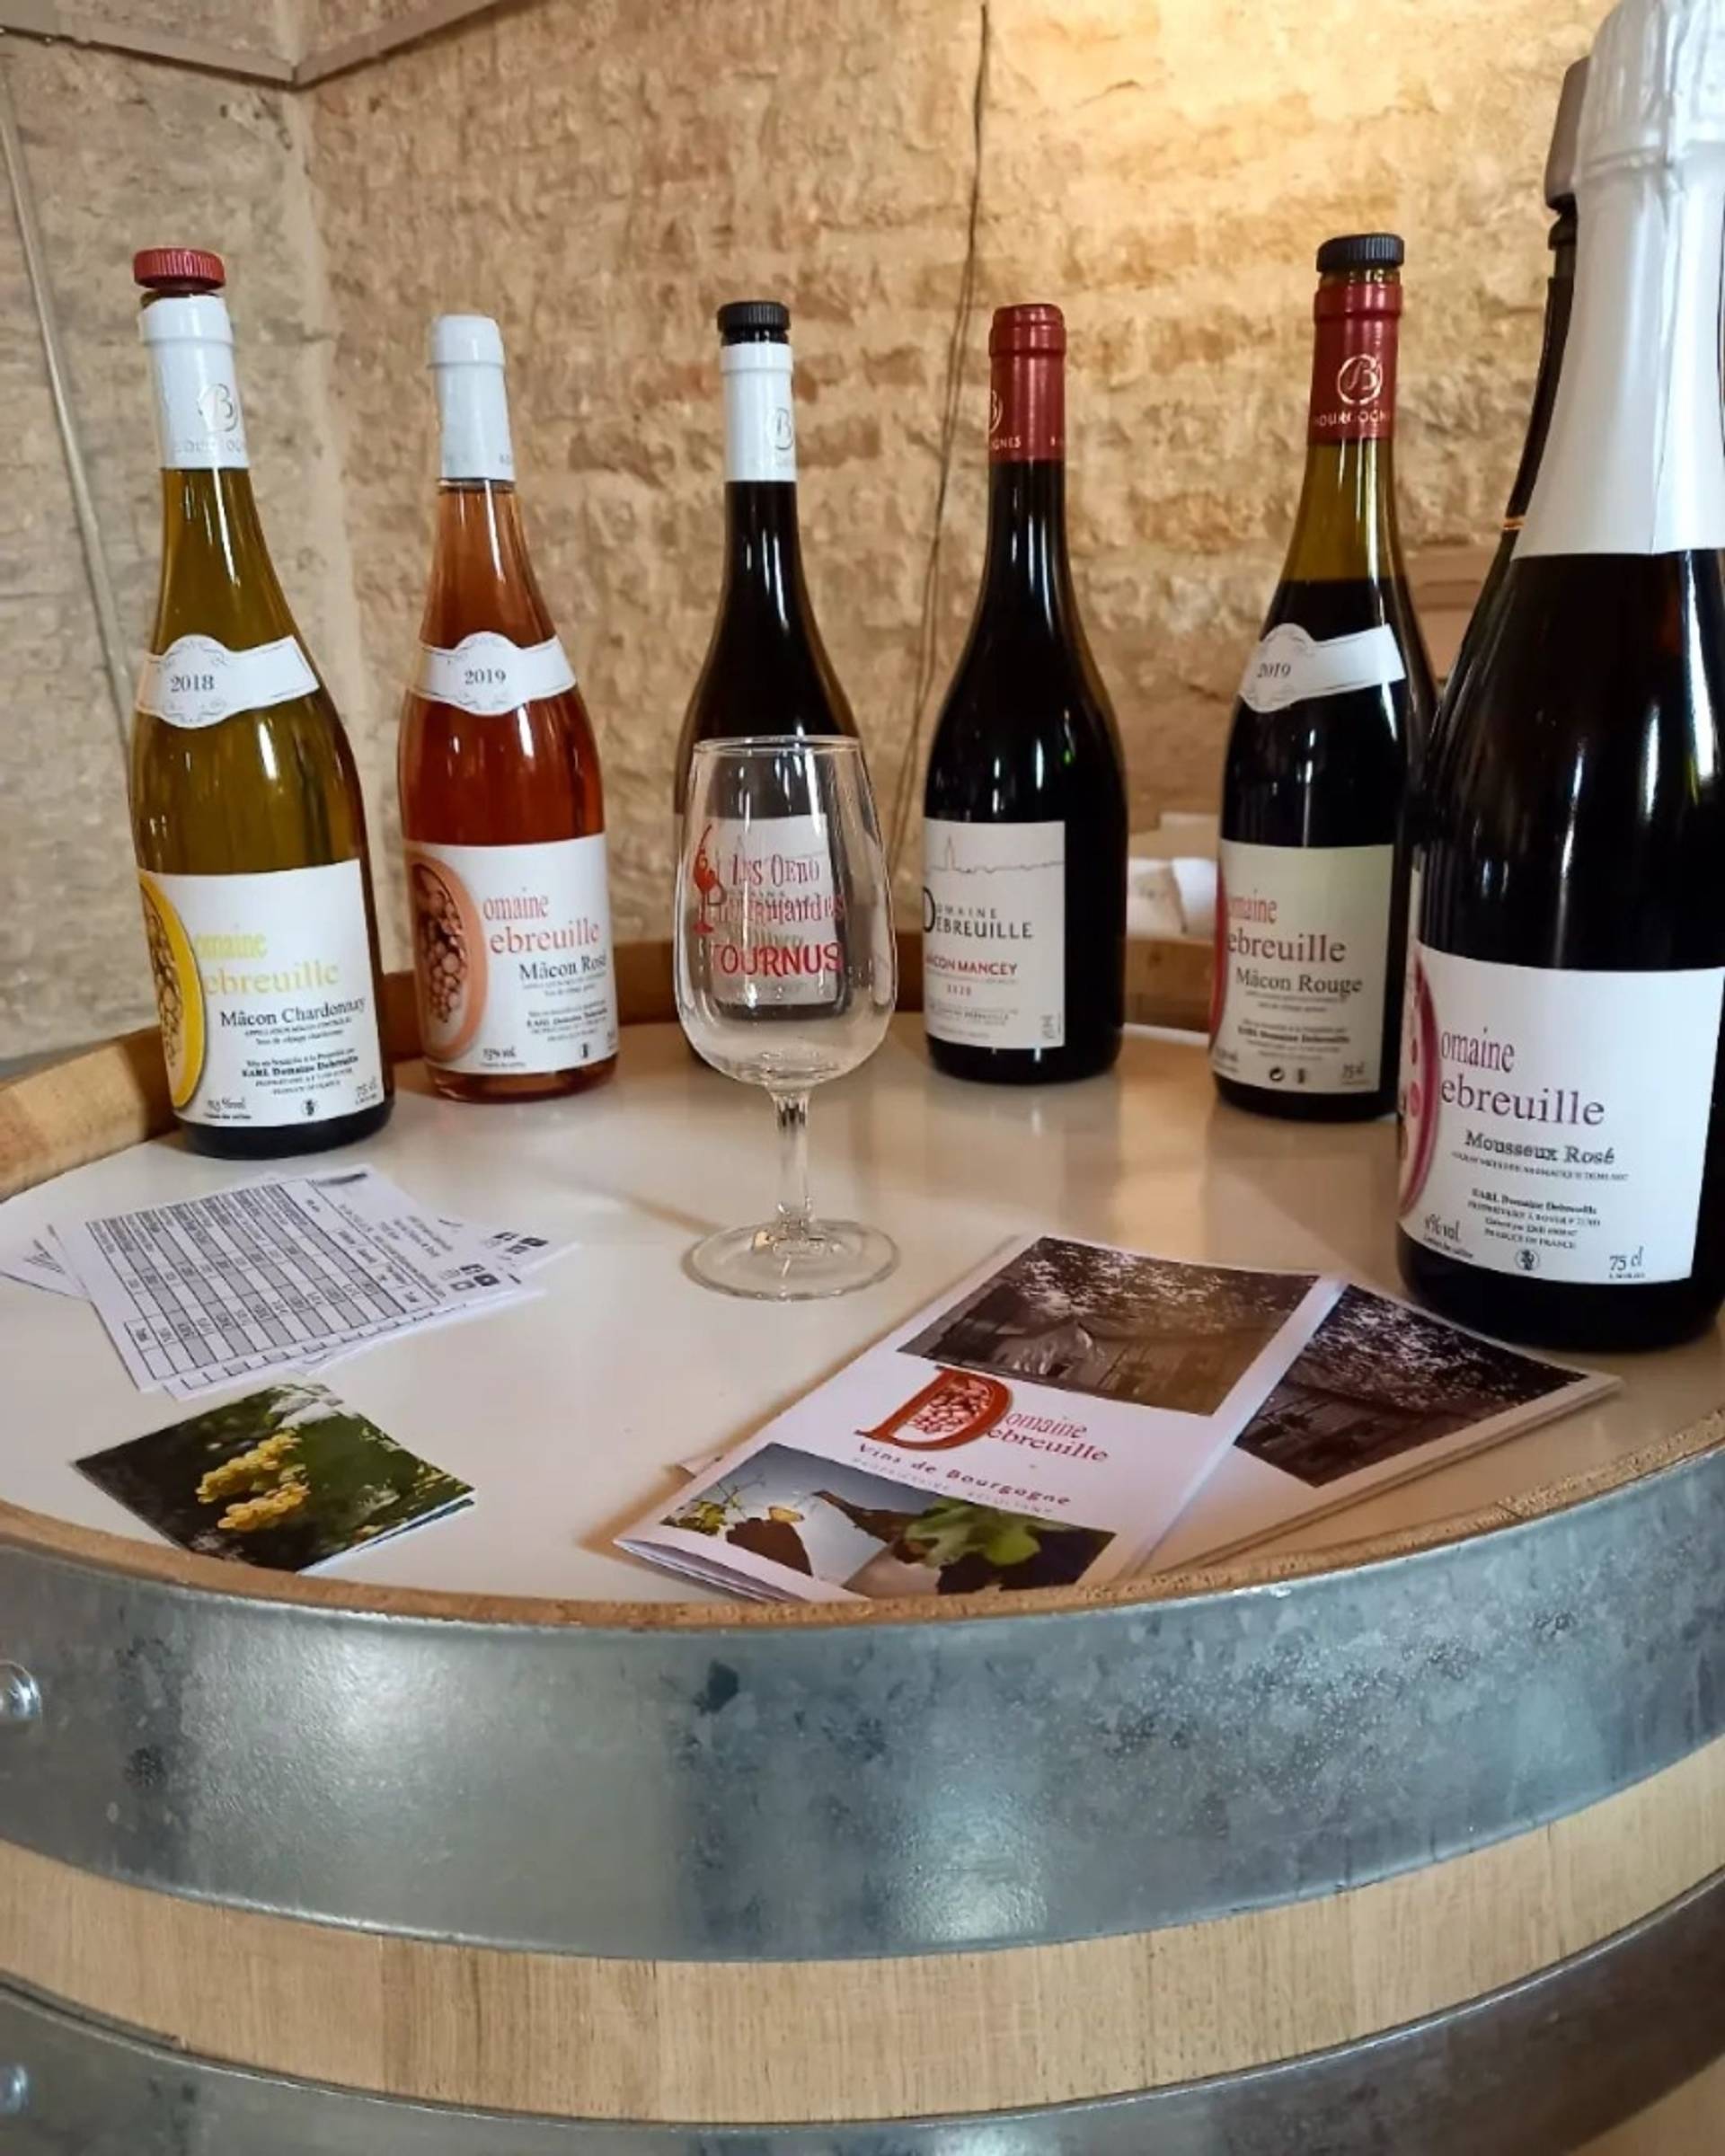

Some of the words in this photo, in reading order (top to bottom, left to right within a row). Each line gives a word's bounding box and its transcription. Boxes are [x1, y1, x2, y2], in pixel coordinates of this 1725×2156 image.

[464, 668, 506, 685] 2019
[1257, 663, 1291, 677] 2019
[171, 675, 216, 693] 2018
[518, 959, 578, 982] Mâcon
[710, 941, 844, 977] TOURNUS
[958, 959, 1018, 976] MANCEY
[1236, 967, 1292, 991] Mâcon
[1298, 974, 1363, 997] Rouge
[220, 1010, 278, 1028] Mâcon
[281, 996, 366, 1025] Chardonnay
[1464, 1129, 1558, 1162] Mousseux
[1563, 1144, 1615, 1165] Rosé
[1609, 1255, 1626, 1271] 75
[859, 1442, 900, 1463] Vins
[911, 1460, 936, 1474] de
[945, 1468, 1071, 1506] Bourgogne
